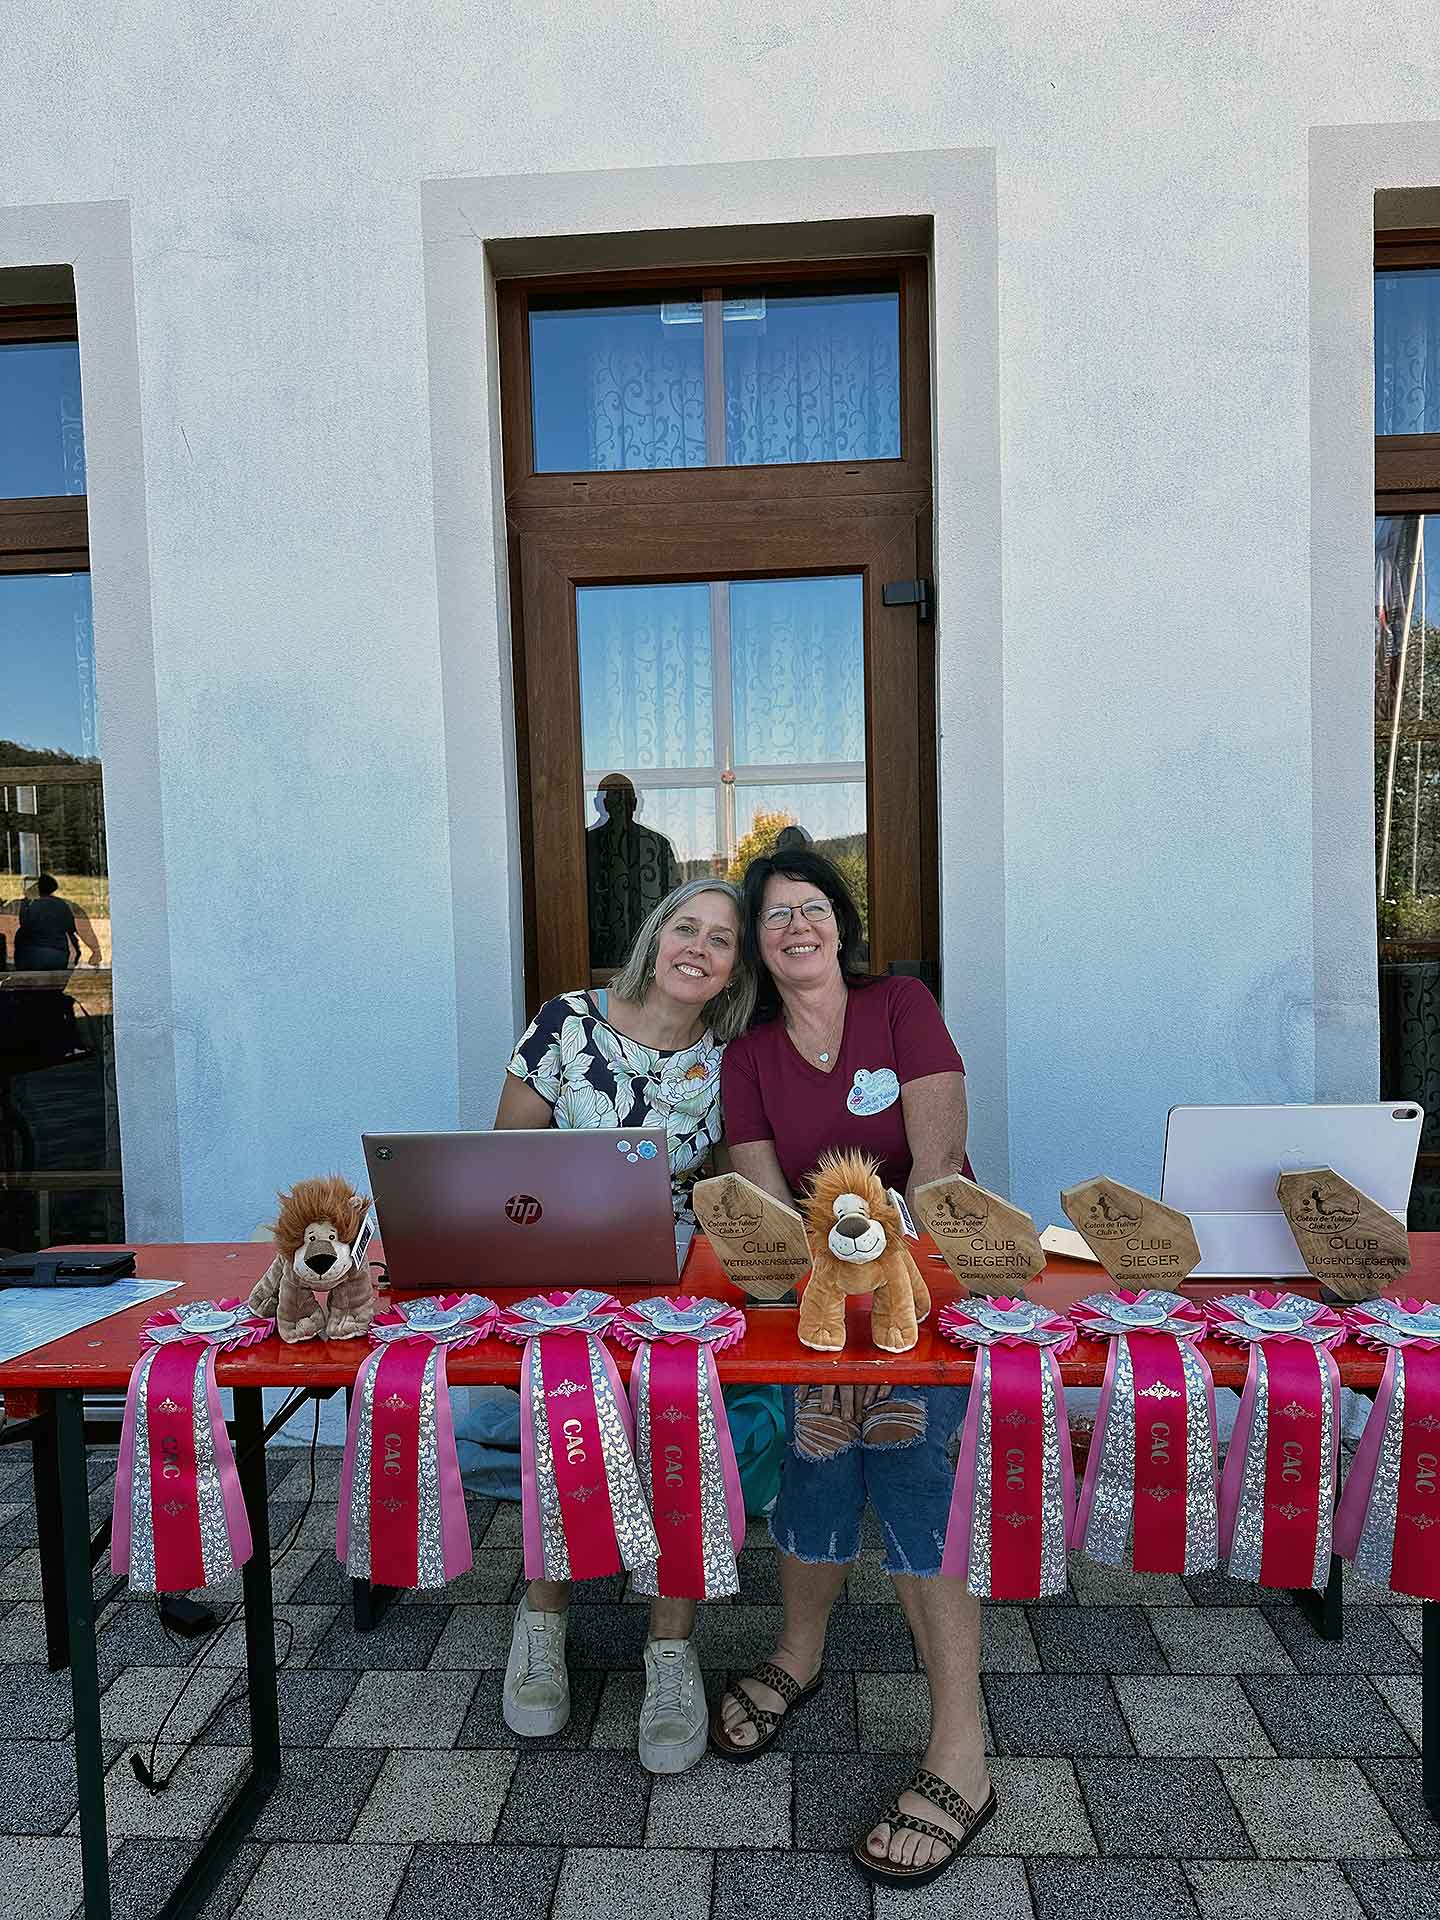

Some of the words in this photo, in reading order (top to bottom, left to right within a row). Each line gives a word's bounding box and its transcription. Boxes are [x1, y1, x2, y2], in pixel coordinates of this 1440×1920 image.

[510, 1194, 539, 1225] hp
[707, 1220, 728, 1228] Coton
[942, 1226, 958, 1234] Club
[1296, 1214, 1318, 1222] Coton
[1319, 1214, 1329, 1222] de
[1308, 1222, 1325, 1230] Club
[161, 1436, 181, 1480] CAC
[384, 1433, 401, 1476] CAC
[563, 1418, 586, 1465] CAC
[1151, 1422, 1170, 1465] CAC
[1282, 1441, 1304, 1482] CAC
[664, 1444, 683, 1488] CAC
[1006, 1448, 1024, 1490] CAC
[1415, 1452, 1438, 1494] CAC
